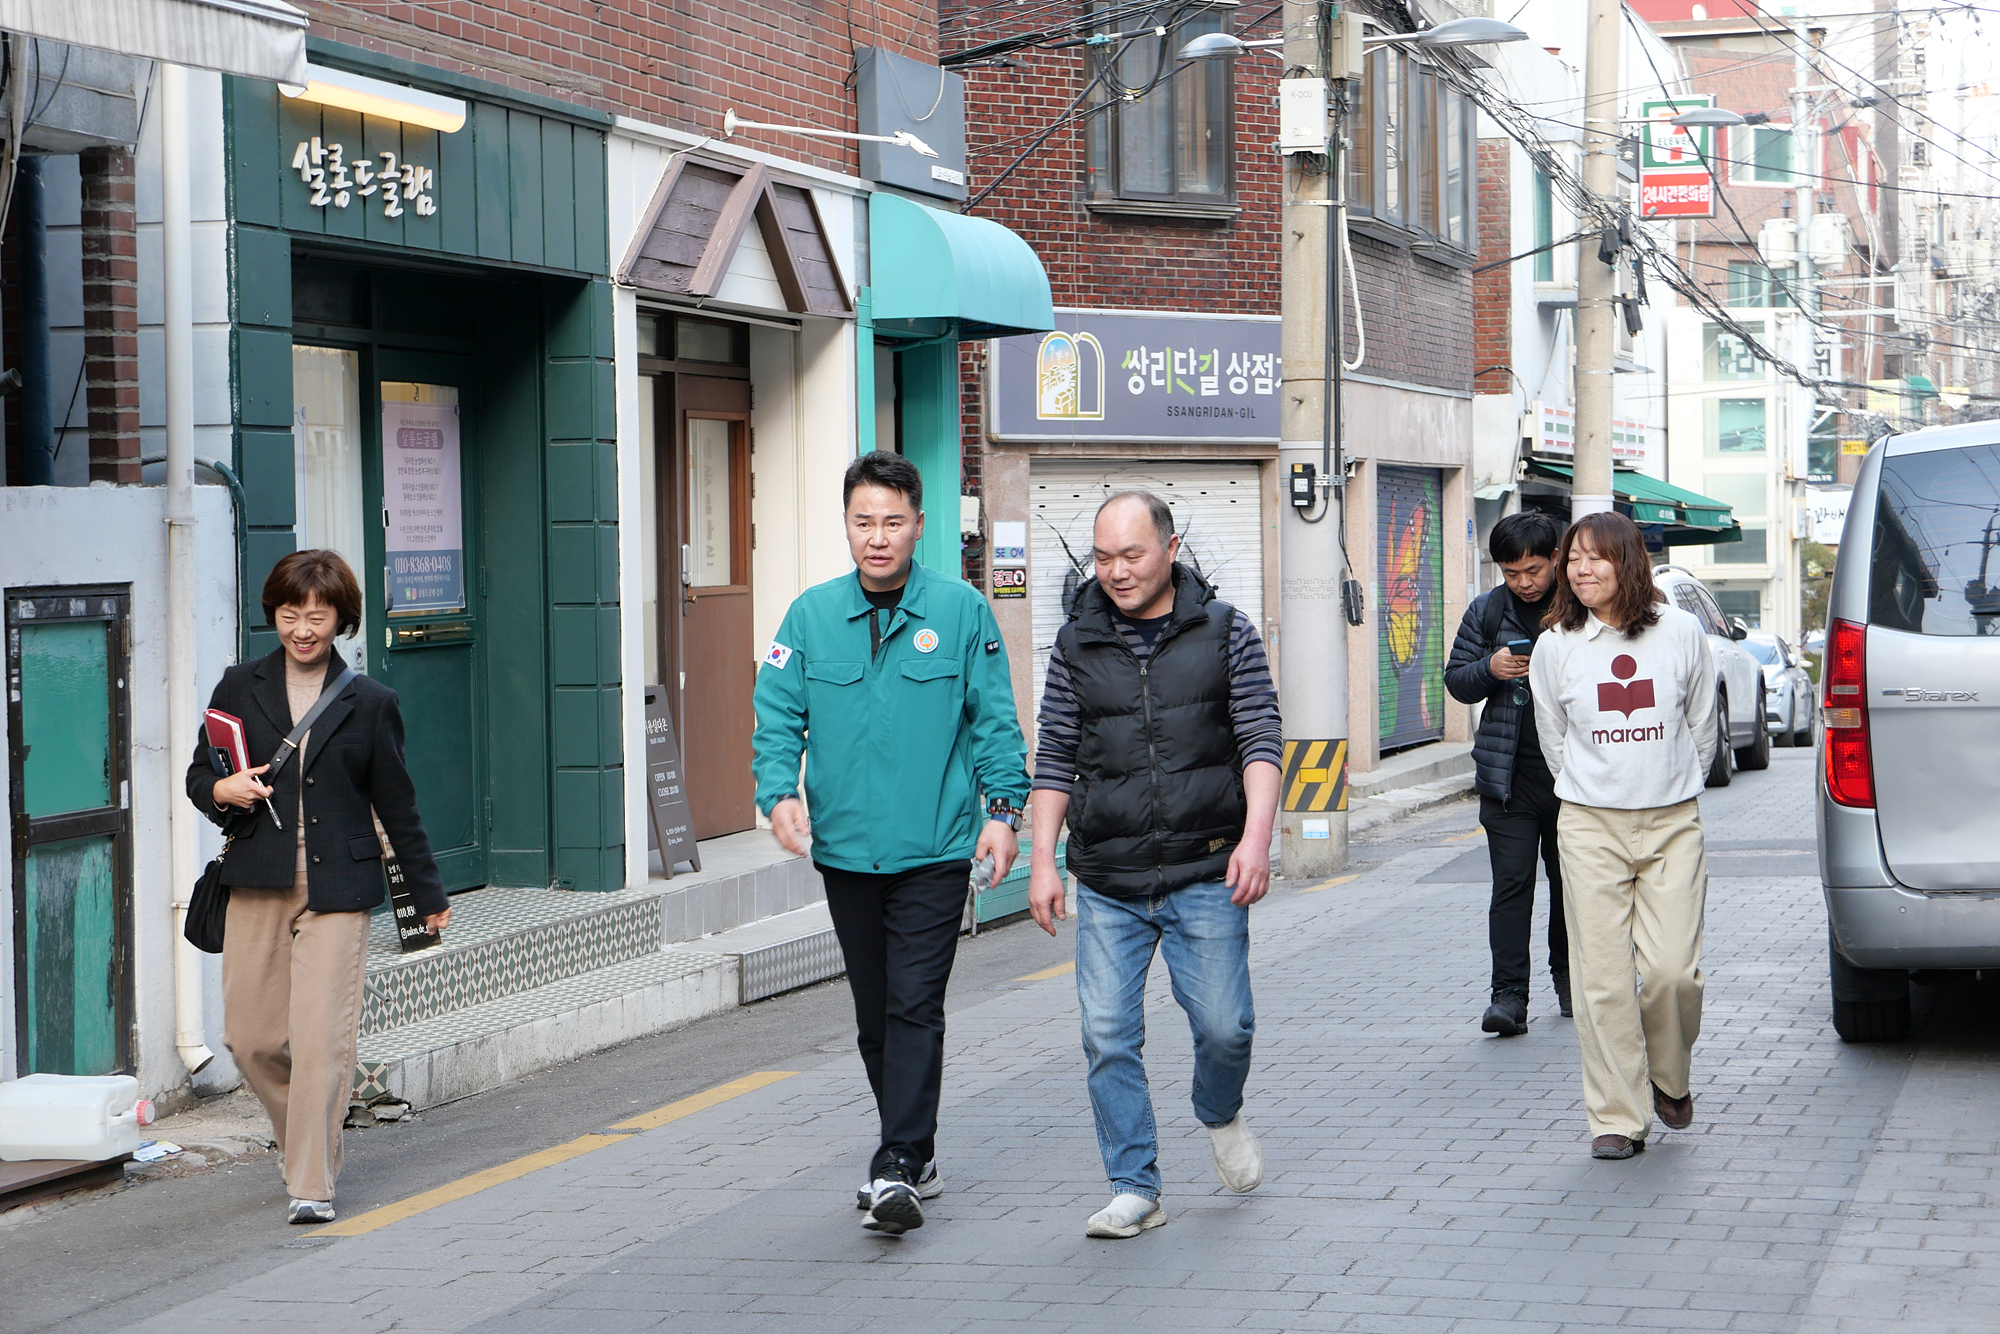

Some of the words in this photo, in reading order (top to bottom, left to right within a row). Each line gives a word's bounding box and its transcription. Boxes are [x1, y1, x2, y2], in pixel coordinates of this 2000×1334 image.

[292, 136, 437, 218] 살롱드글램
[1643, 185, 1709, 204] 24시간편의점
[1121, 345, 1220, 397] 쌍리단길
[995, 548, 1025, 558] SECOM
[395, 555, 451, 574] 010-8368-0408
[993, 570, 1014, 587] 경고
[1905, 687, 1979, 702] Starex
[1592, 721, 1665, 744] marant
